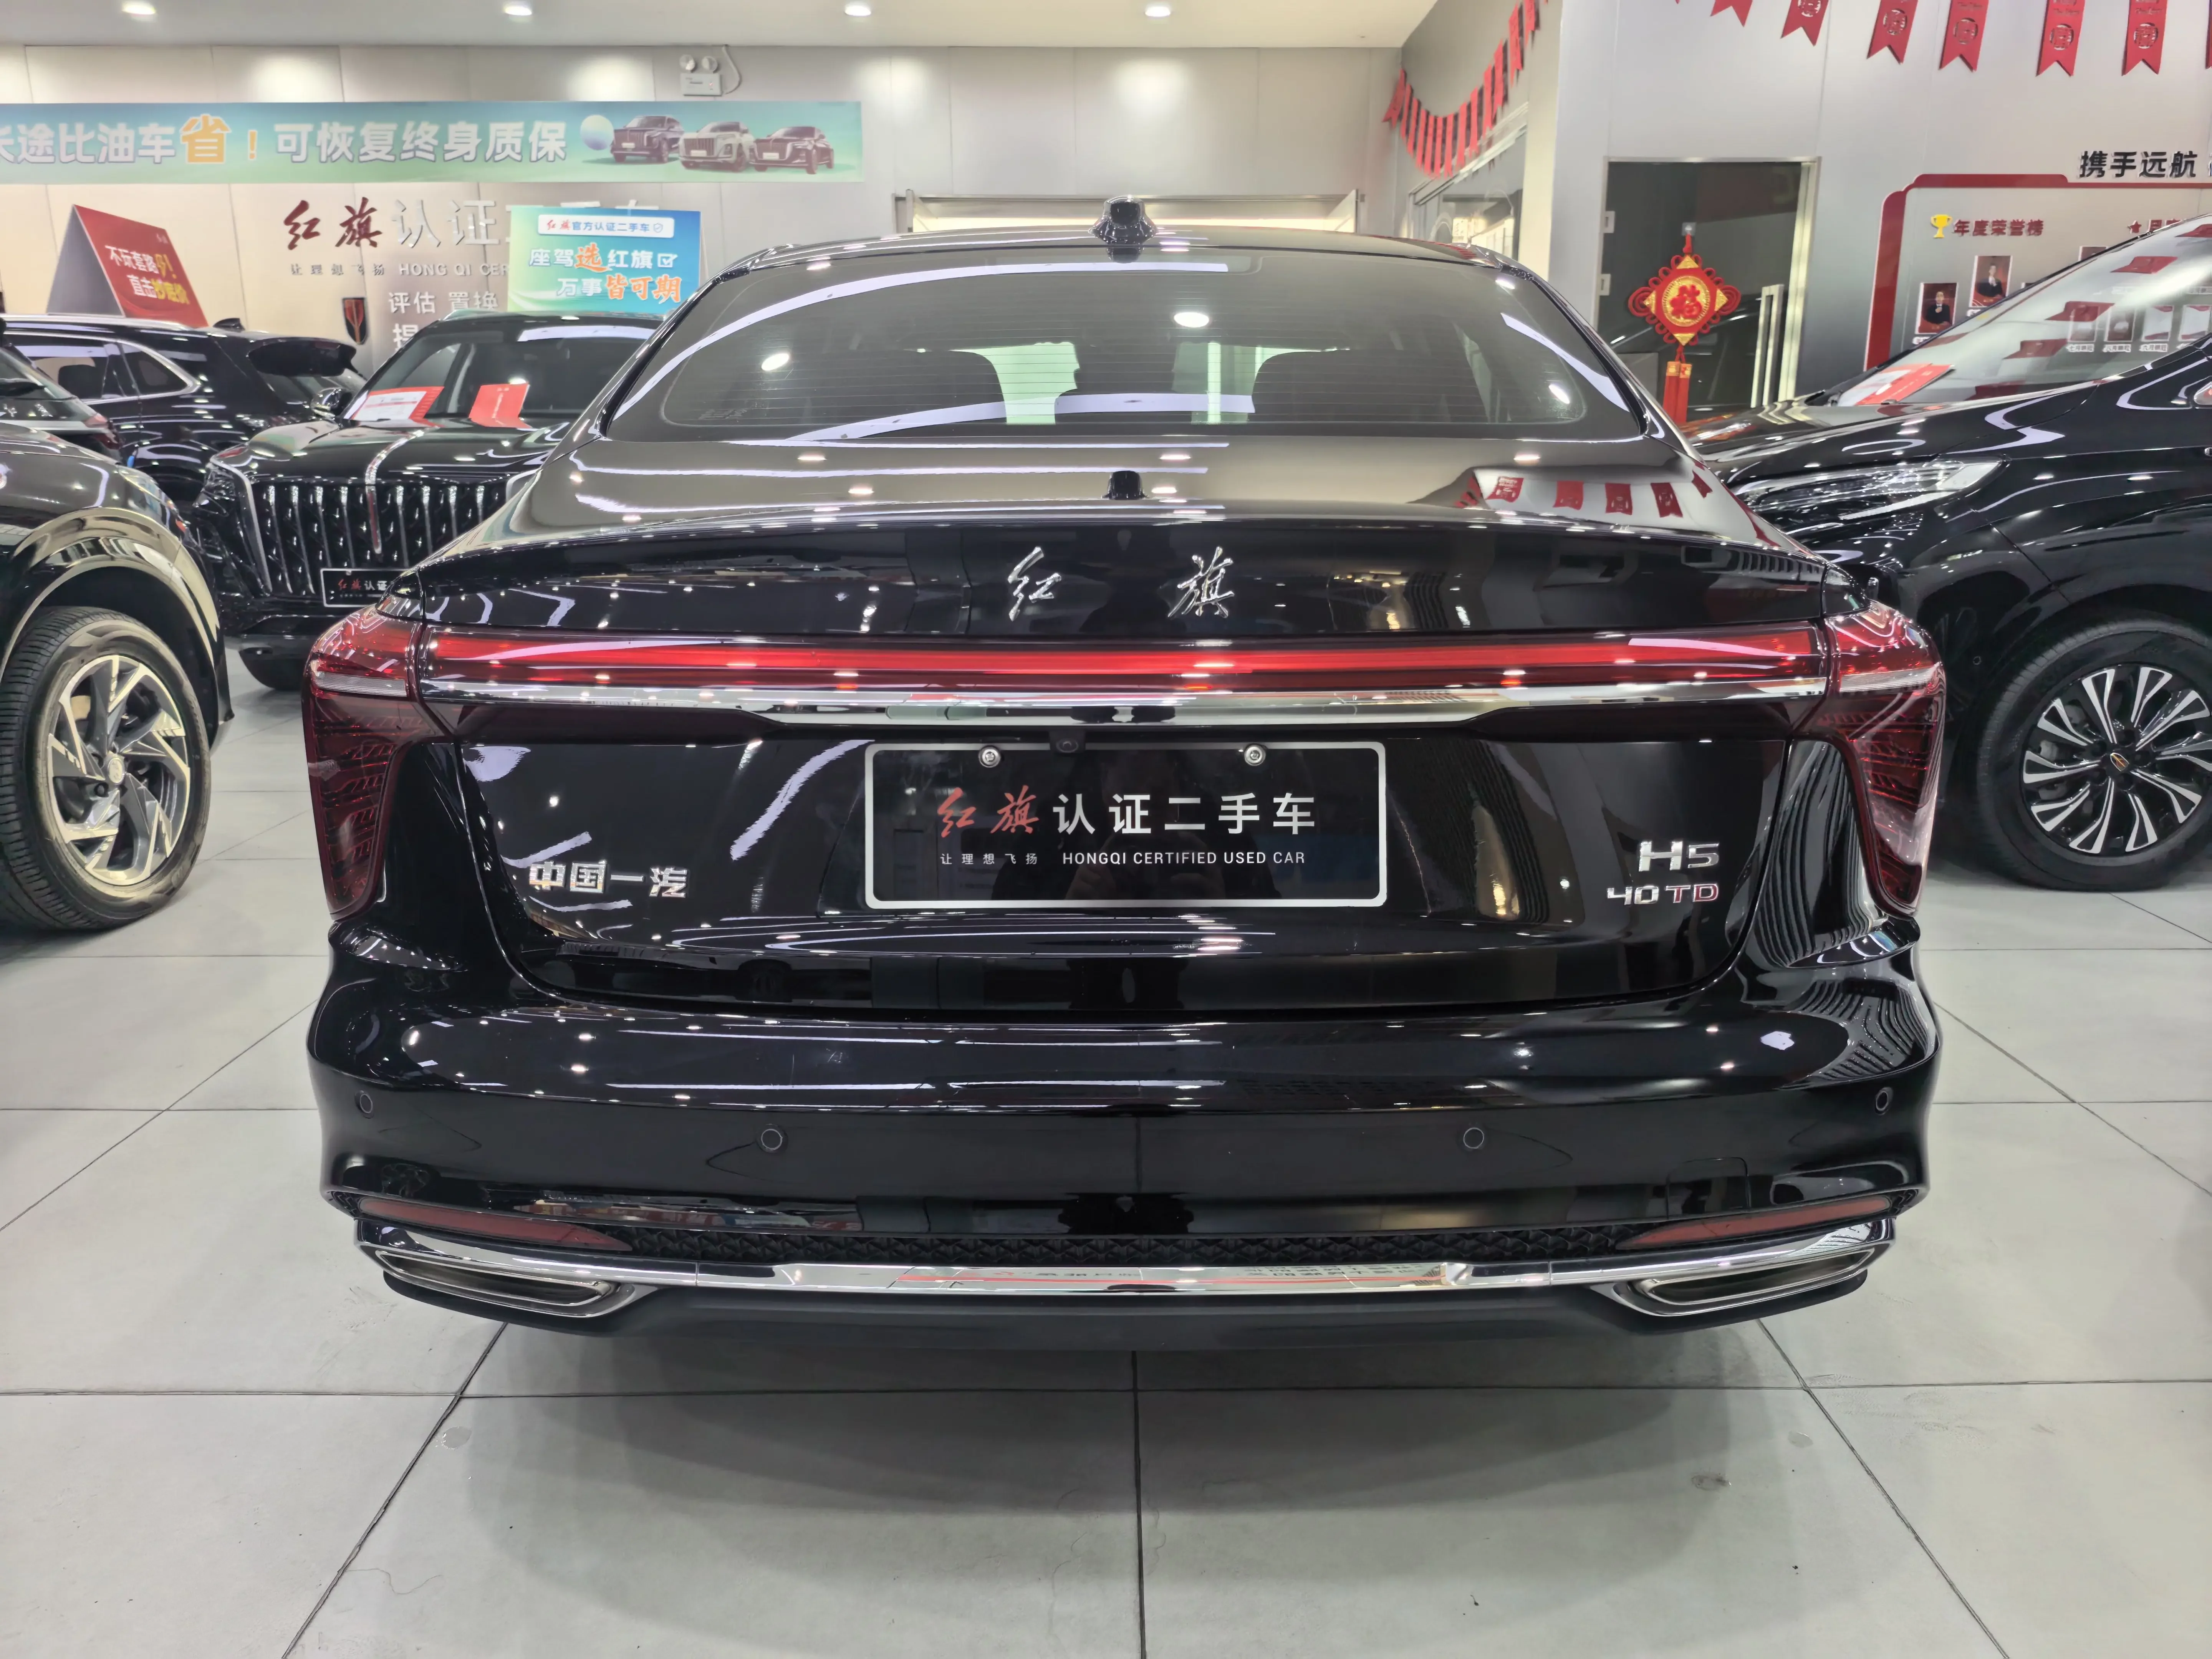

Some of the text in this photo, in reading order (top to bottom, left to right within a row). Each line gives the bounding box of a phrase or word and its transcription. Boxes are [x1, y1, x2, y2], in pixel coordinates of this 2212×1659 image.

[2078, 151, 2198, 178] 携手远航
[1953, 219, 2044, 237] 年度荣誉榜
[399, 263, 447, 276] HONG
[454, 263, 471, 276] QI
[529, 242, 654, 272] 座驾选红旗
[556, 273, 682, 304] 万事皆可期
[389, 291, 499, 314] 评估 置换
[940, 852, 1305, 865] 让理想飞扬 HONGQI CERTIFIED USED CAR
[1639, 841, 1720, 872] H5
[529, 860, 688, 898] 中国一汽
